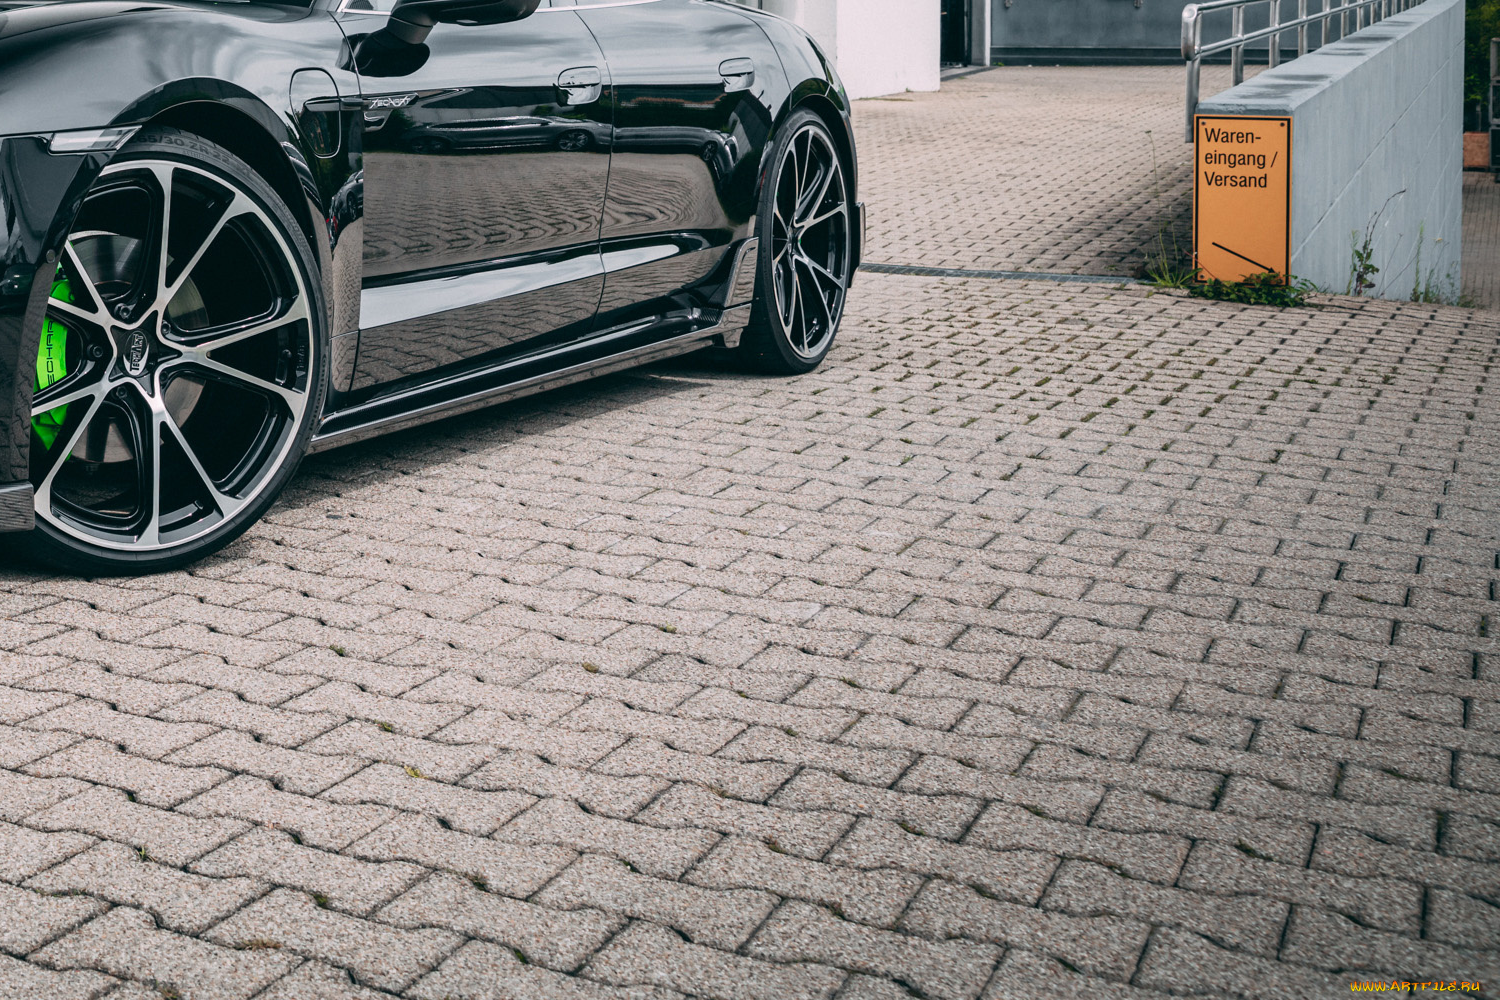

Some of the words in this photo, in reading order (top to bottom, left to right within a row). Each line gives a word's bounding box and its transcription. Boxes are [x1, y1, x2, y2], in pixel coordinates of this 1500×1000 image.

[1204, 127, 1262, 144] Waren-
[1204, 149, 1267, 170] eingang
[1270, 151, 1279, 168] /
[1204, 171, 1268, 189] Versand
[45, 320, 56, 387] ECHAR
